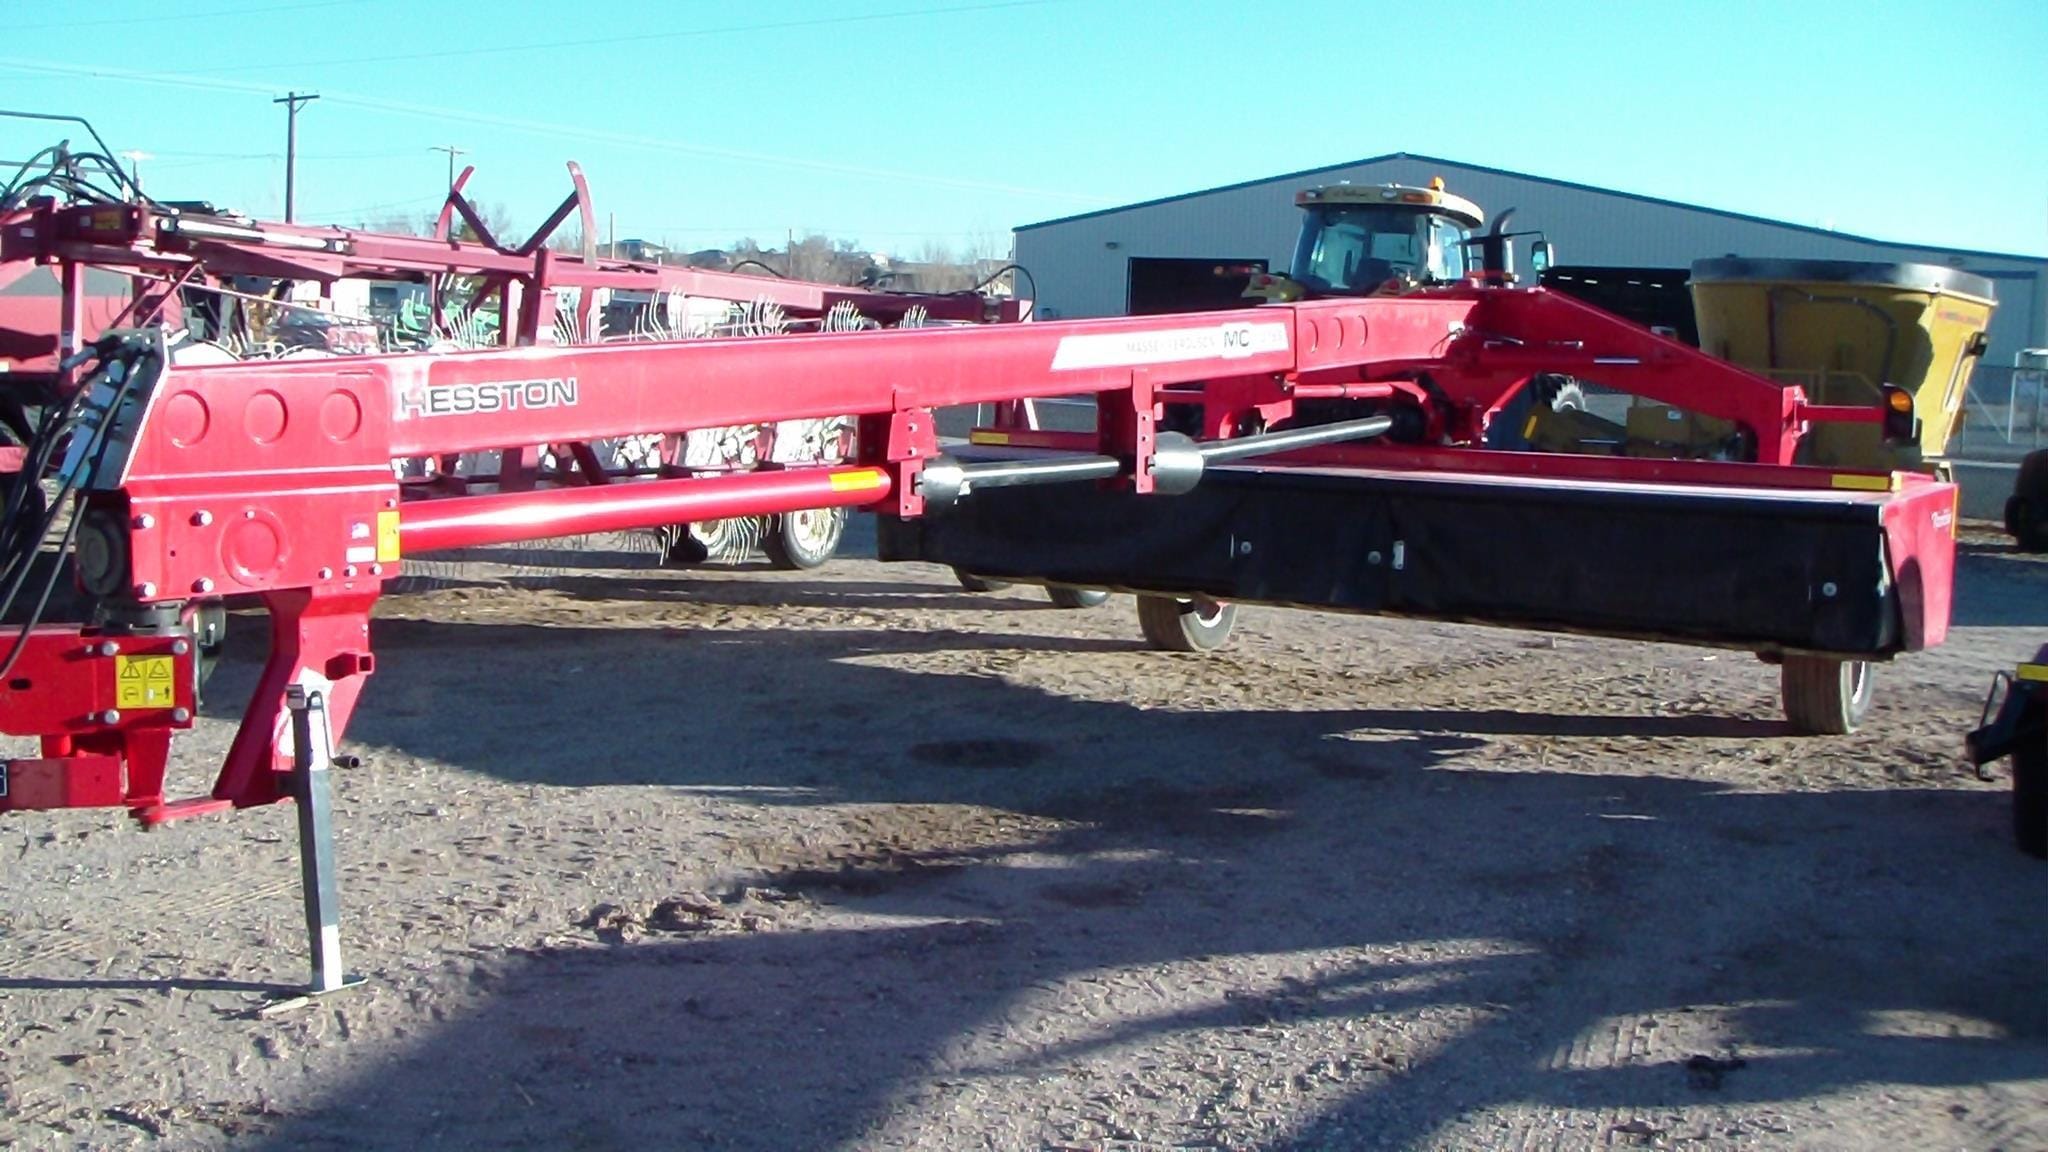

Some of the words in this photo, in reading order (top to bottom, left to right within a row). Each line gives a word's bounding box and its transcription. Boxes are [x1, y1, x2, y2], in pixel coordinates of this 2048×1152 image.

[1126, 339, 1164, 353] MASSE
[1223, 328, 1250, 348] MC
[400, 378, 577, 415] HESSTON
